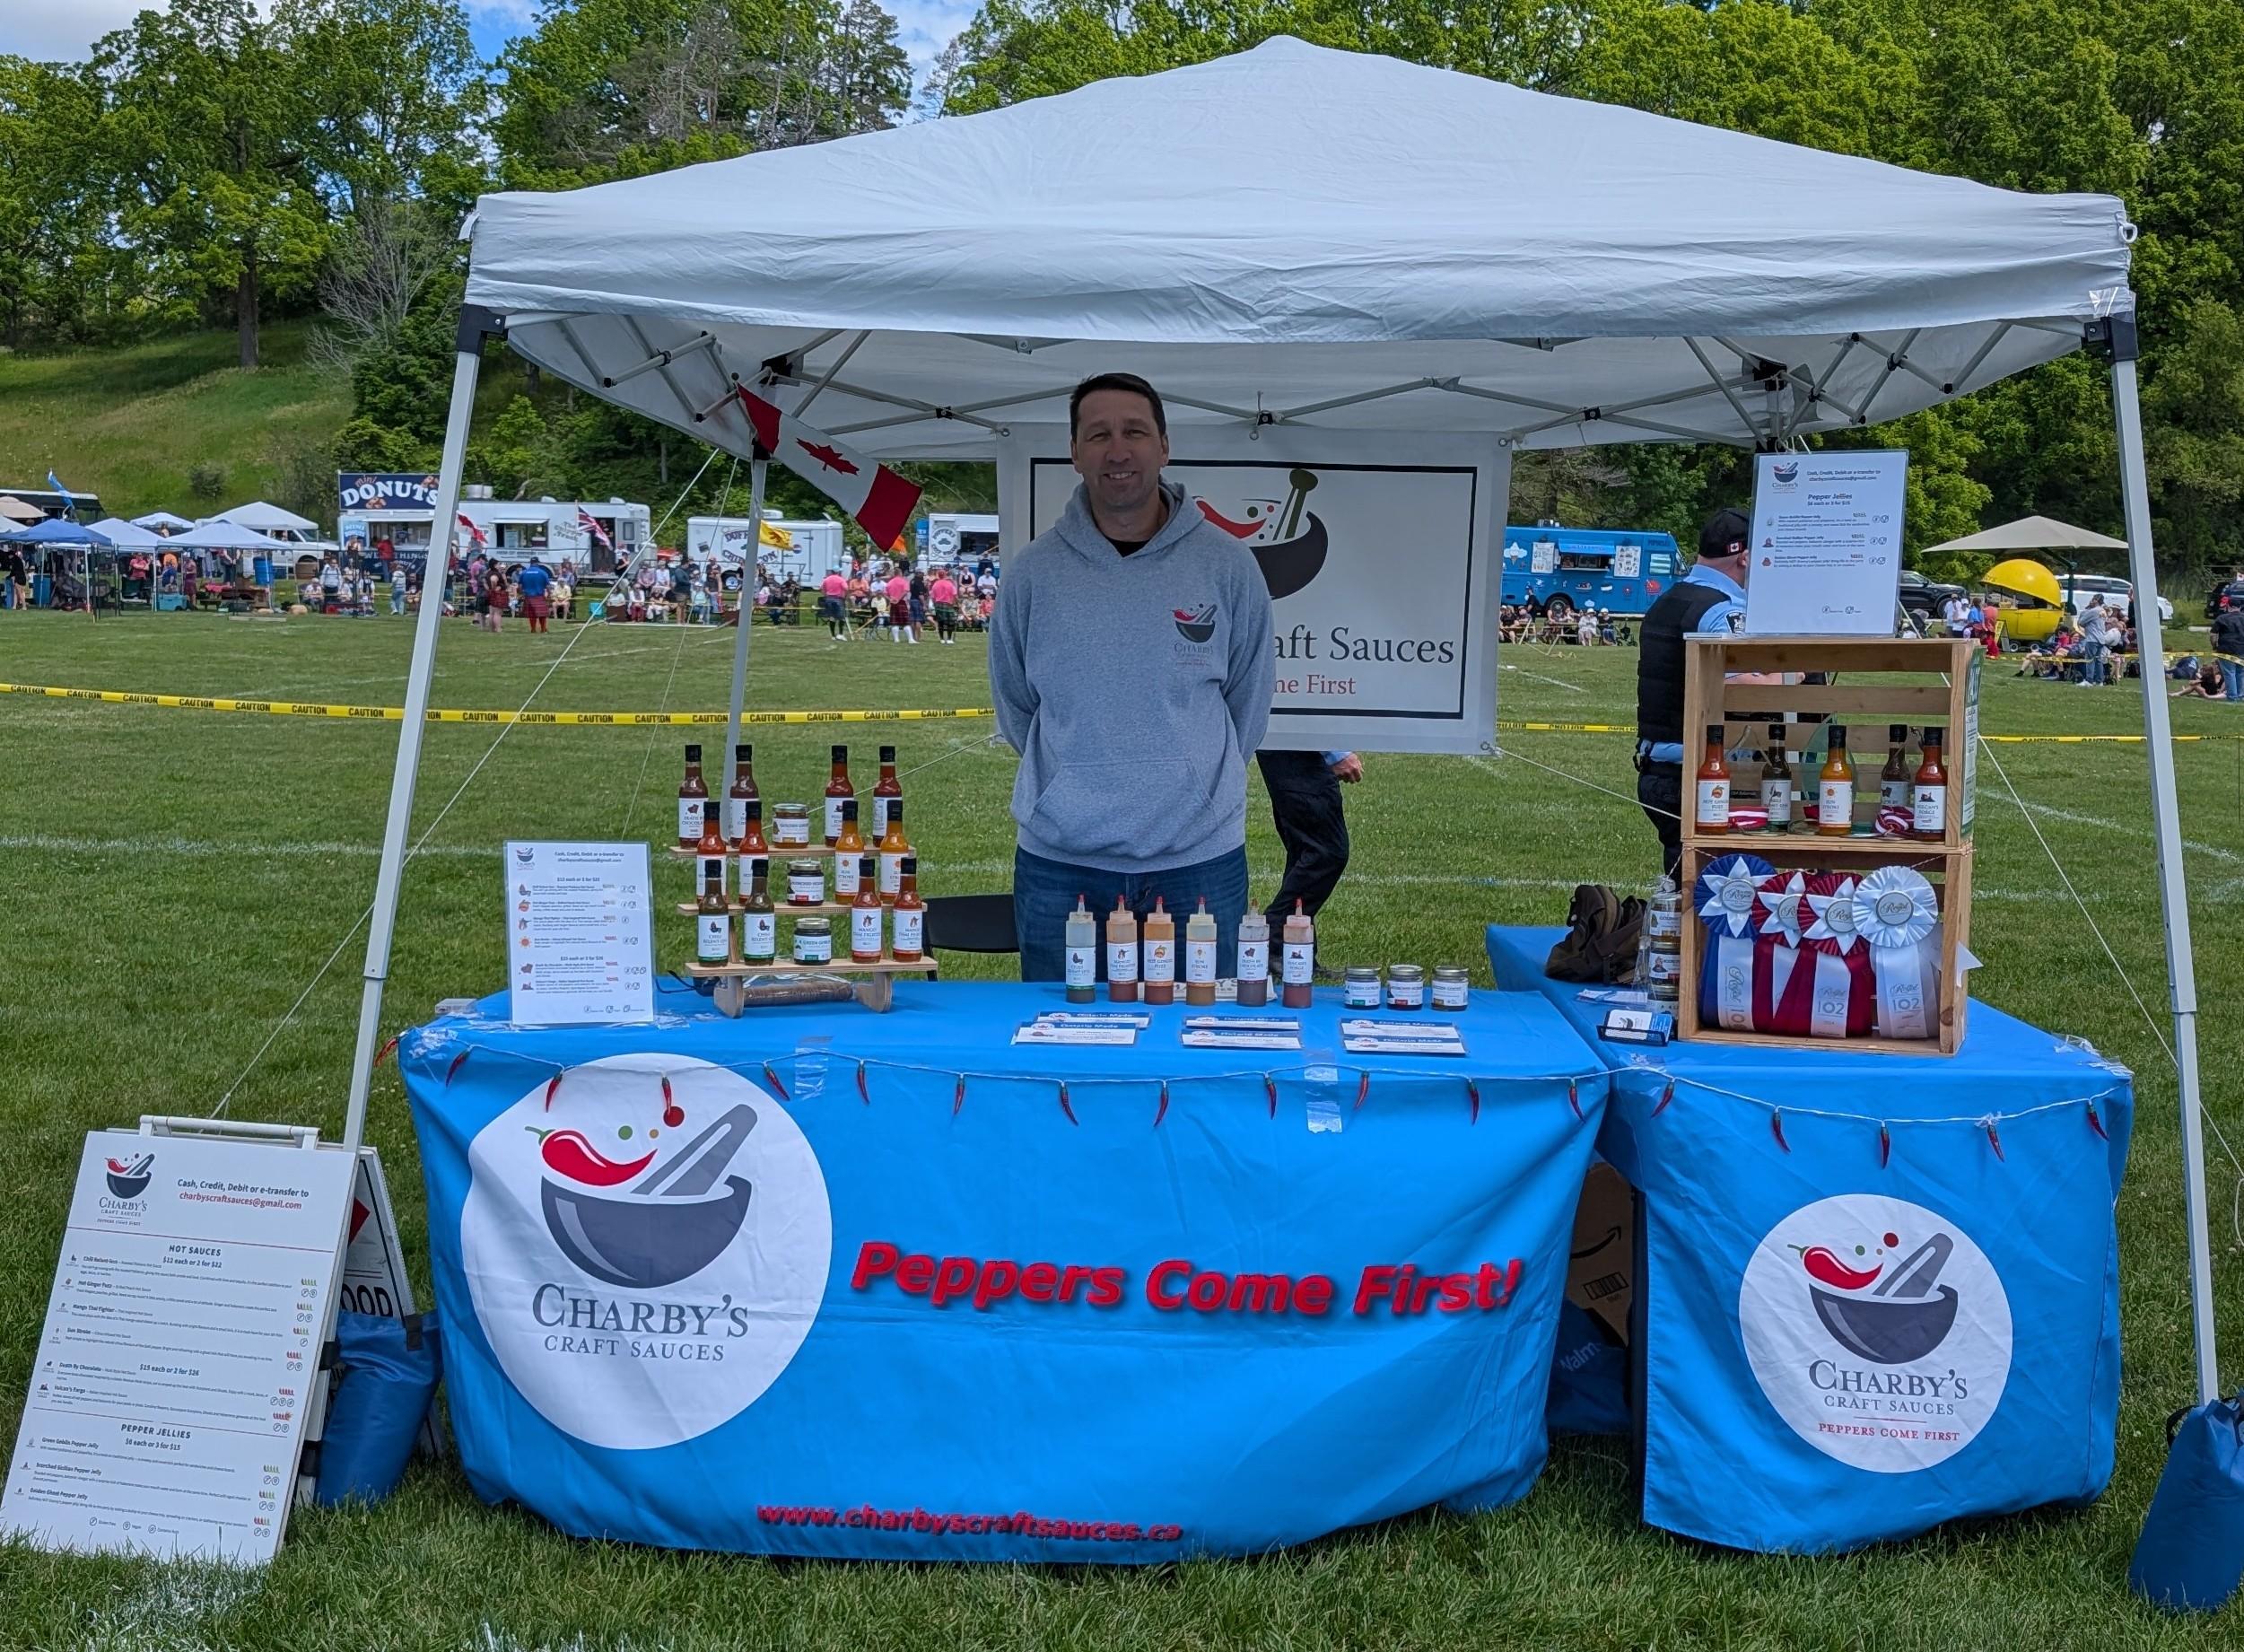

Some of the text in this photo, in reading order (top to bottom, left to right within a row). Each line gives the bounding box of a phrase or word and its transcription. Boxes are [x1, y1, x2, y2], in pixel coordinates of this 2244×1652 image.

[1275, 625, 1454, 663] aft Sauces
[1306, 674, 1357, 695] First
[179, 698, 214, 708] CAUTION
[235, 702, 271, 712] CAUTION
[292, 704, 327, 715] CAUTION
[348, 708, 384, 717] CAUTION
[462, 712, 499, 721] CAUTION
[520, 713, 555, 722] CAUTION
[578, 714, 614, 723] CAUTION
[635, 714, 671, 723] CAUTION
[693, 714, 728, 723] CAUTION
[750, 713, 786, 722] CAUTION
[807, 712, 843, 721] CAUTION
[1817, 1001, 1845, 1015] 102
[1892, 998, 1920, 1011] 102
[178, 1178, 198, 1189] Cash,
[200, 1180, 225, 1192] Credit,
[227, 1183, 249, 1193] Debit
[260, 1186, 300, 1197] e-transfer
[301, 1189, 310, 1198] to
[99, 1196, 148, 1212] CHARBY'S
[179, 1191, 302, 1210] charbyscraftsauces@gmail.com
[169, 1245, 221, 1257] HOT SAUCES
[851, 1240, 1522, 1315] Peppers Come First!
[341, 1285, 393, 1317] OOD
[533, 1282, 748, 1337] CHARBY'S
[544, 1334, 725, 1361] CRAFT SAUCES
[151, 1365, 166, 1373] each
[173, 1367, 179, 1375] 2
[179, 1367, 188, 1375] for
[1809, 1359, 1968, 1400] CHARBY'S
[1824, 1394, 1954, 1415] CRAFT SAUCES
[121, 1423, 191, 1439] PEPPER JELLIES
[1819, 1423, 1960, 1441] PEPPERS COME FIRST
[71, 1439, 88, 1448] Pepper
[88, 1441, 99, 1449] Jelly
[133, 1439, 147, 1447] each
[160, 1441, 170, 1449] for
[756, 1504, 1182, 1541] www.charbyscraftsauces.ca
